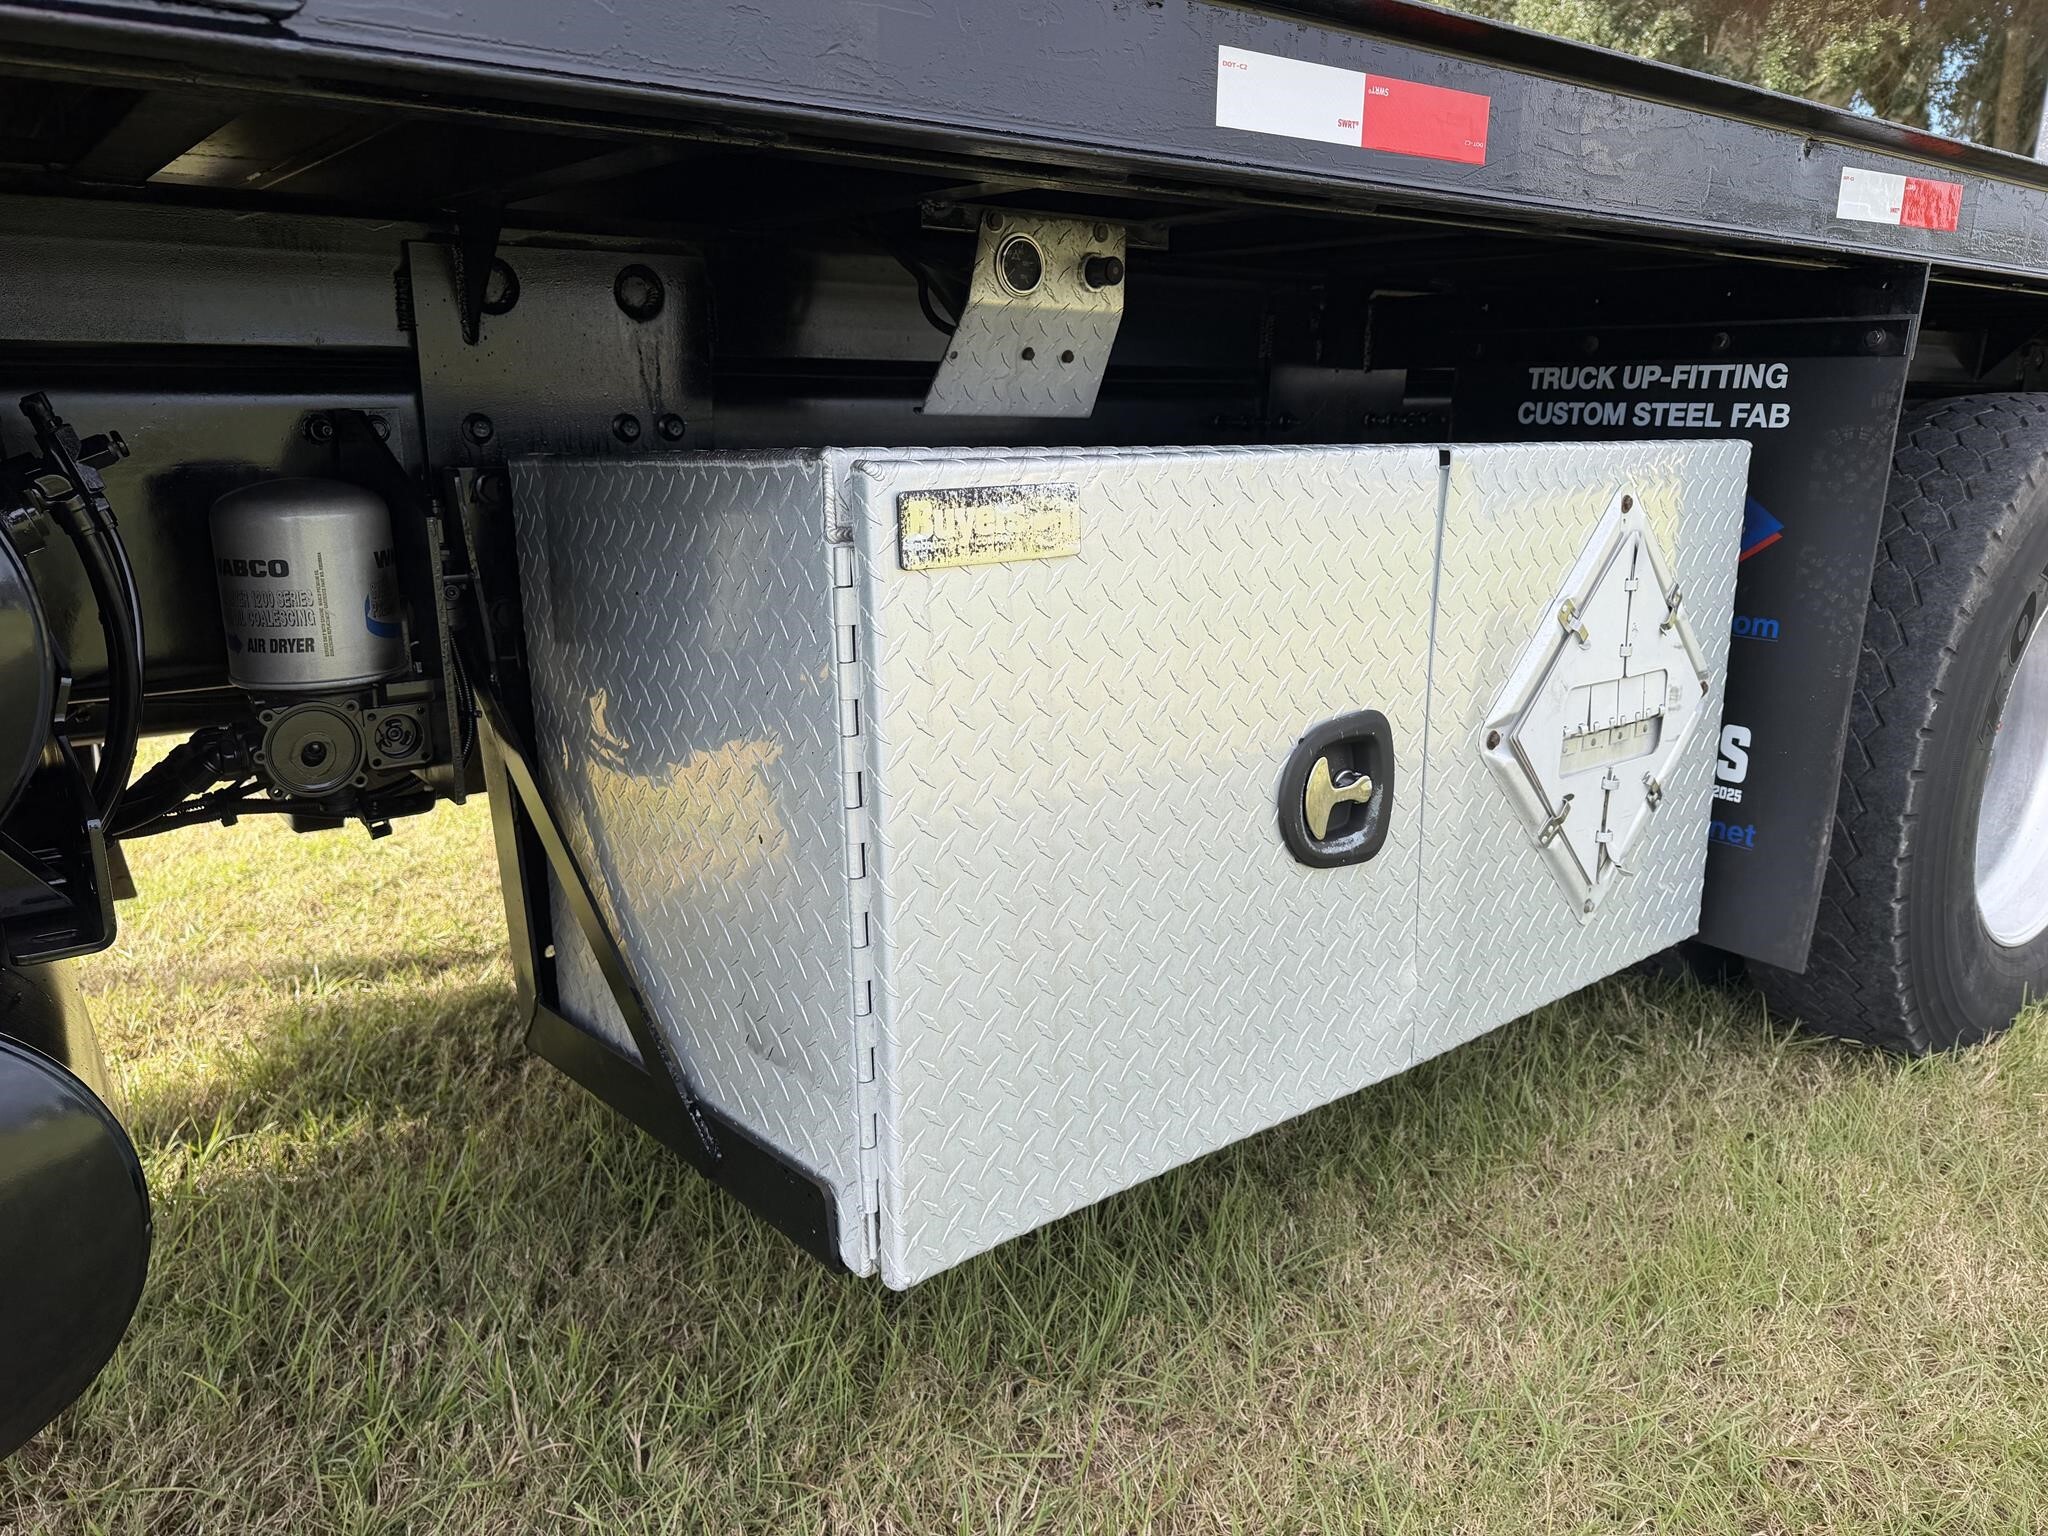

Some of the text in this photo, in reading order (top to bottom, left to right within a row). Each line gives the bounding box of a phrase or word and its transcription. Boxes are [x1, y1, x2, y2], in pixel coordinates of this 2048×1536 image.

[1222, 60, 1248, 71] DOT-C2
[1529, 363, 1789, 390] TRUCK UP-FITTING
[1517, 402, 1791, 429] CUSTOM STEEL FAB
[218, 559, 290, 578] ABCO
[247, 637, 315, 654] AIR DRYER
[1713, 784, 1743, 803] 2025
